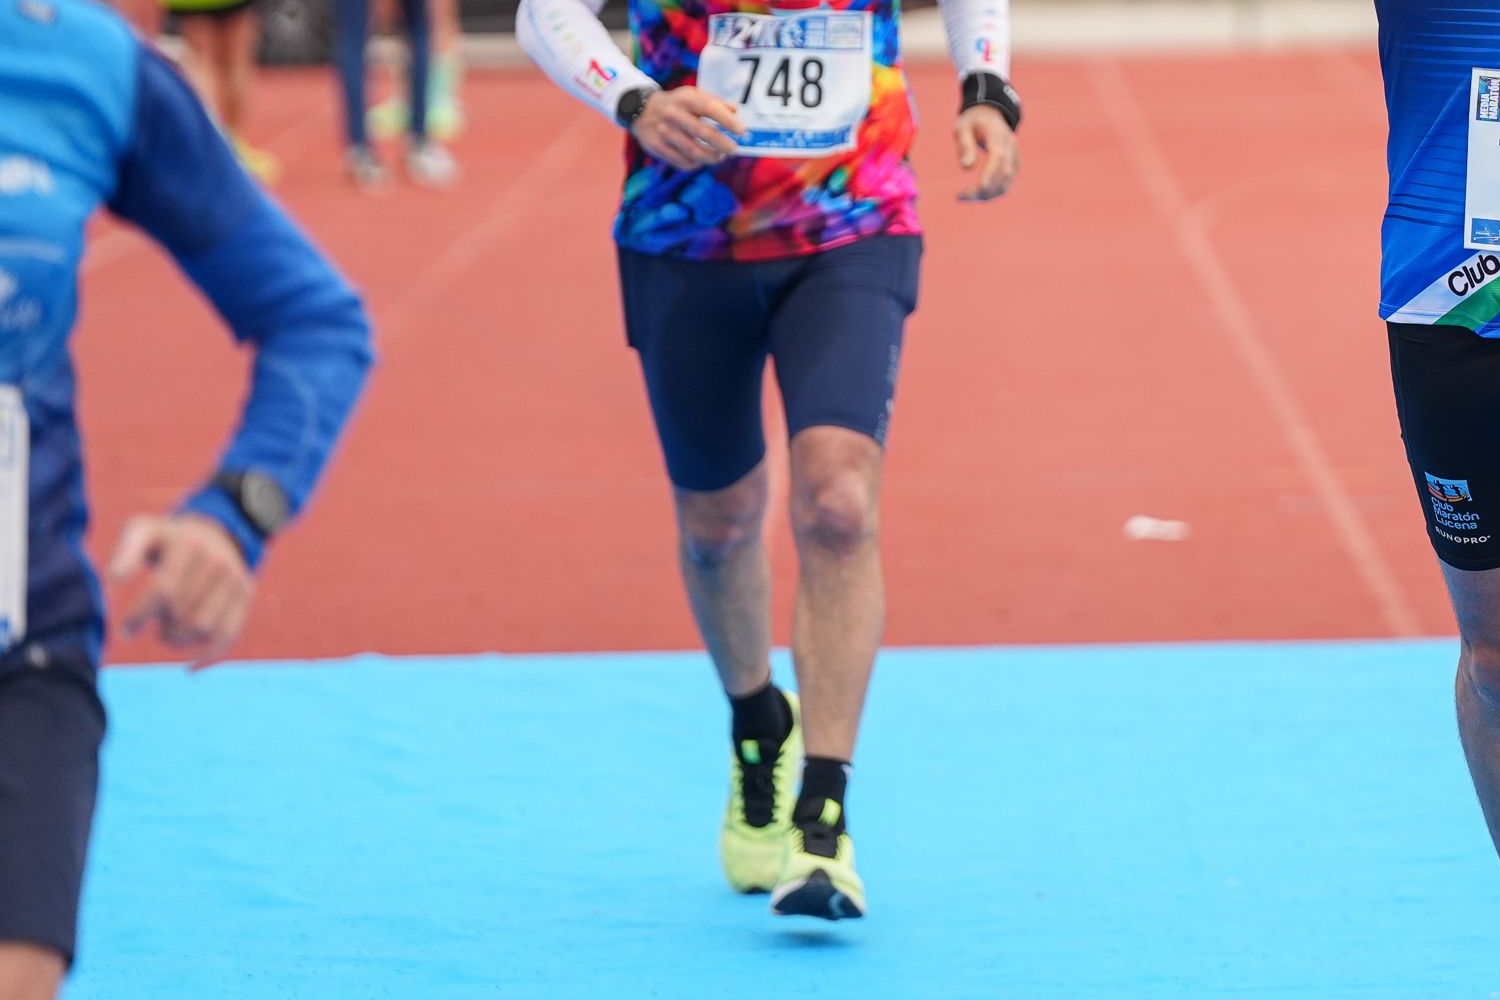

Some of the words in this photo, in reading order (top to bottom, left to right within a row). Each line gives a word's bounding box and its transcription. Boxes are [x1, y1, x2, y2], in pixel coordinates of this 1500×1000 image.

[737, 54, 824, 109] 748
[1480, 93, 1490, 119] MEDIA
[1447, 254, 1500, 297] Club
[1431, 496, 1454, 512] Club
[1433, 504, 1480, 522] Maratón
[1435, 513, 1478, 530] Lucena
